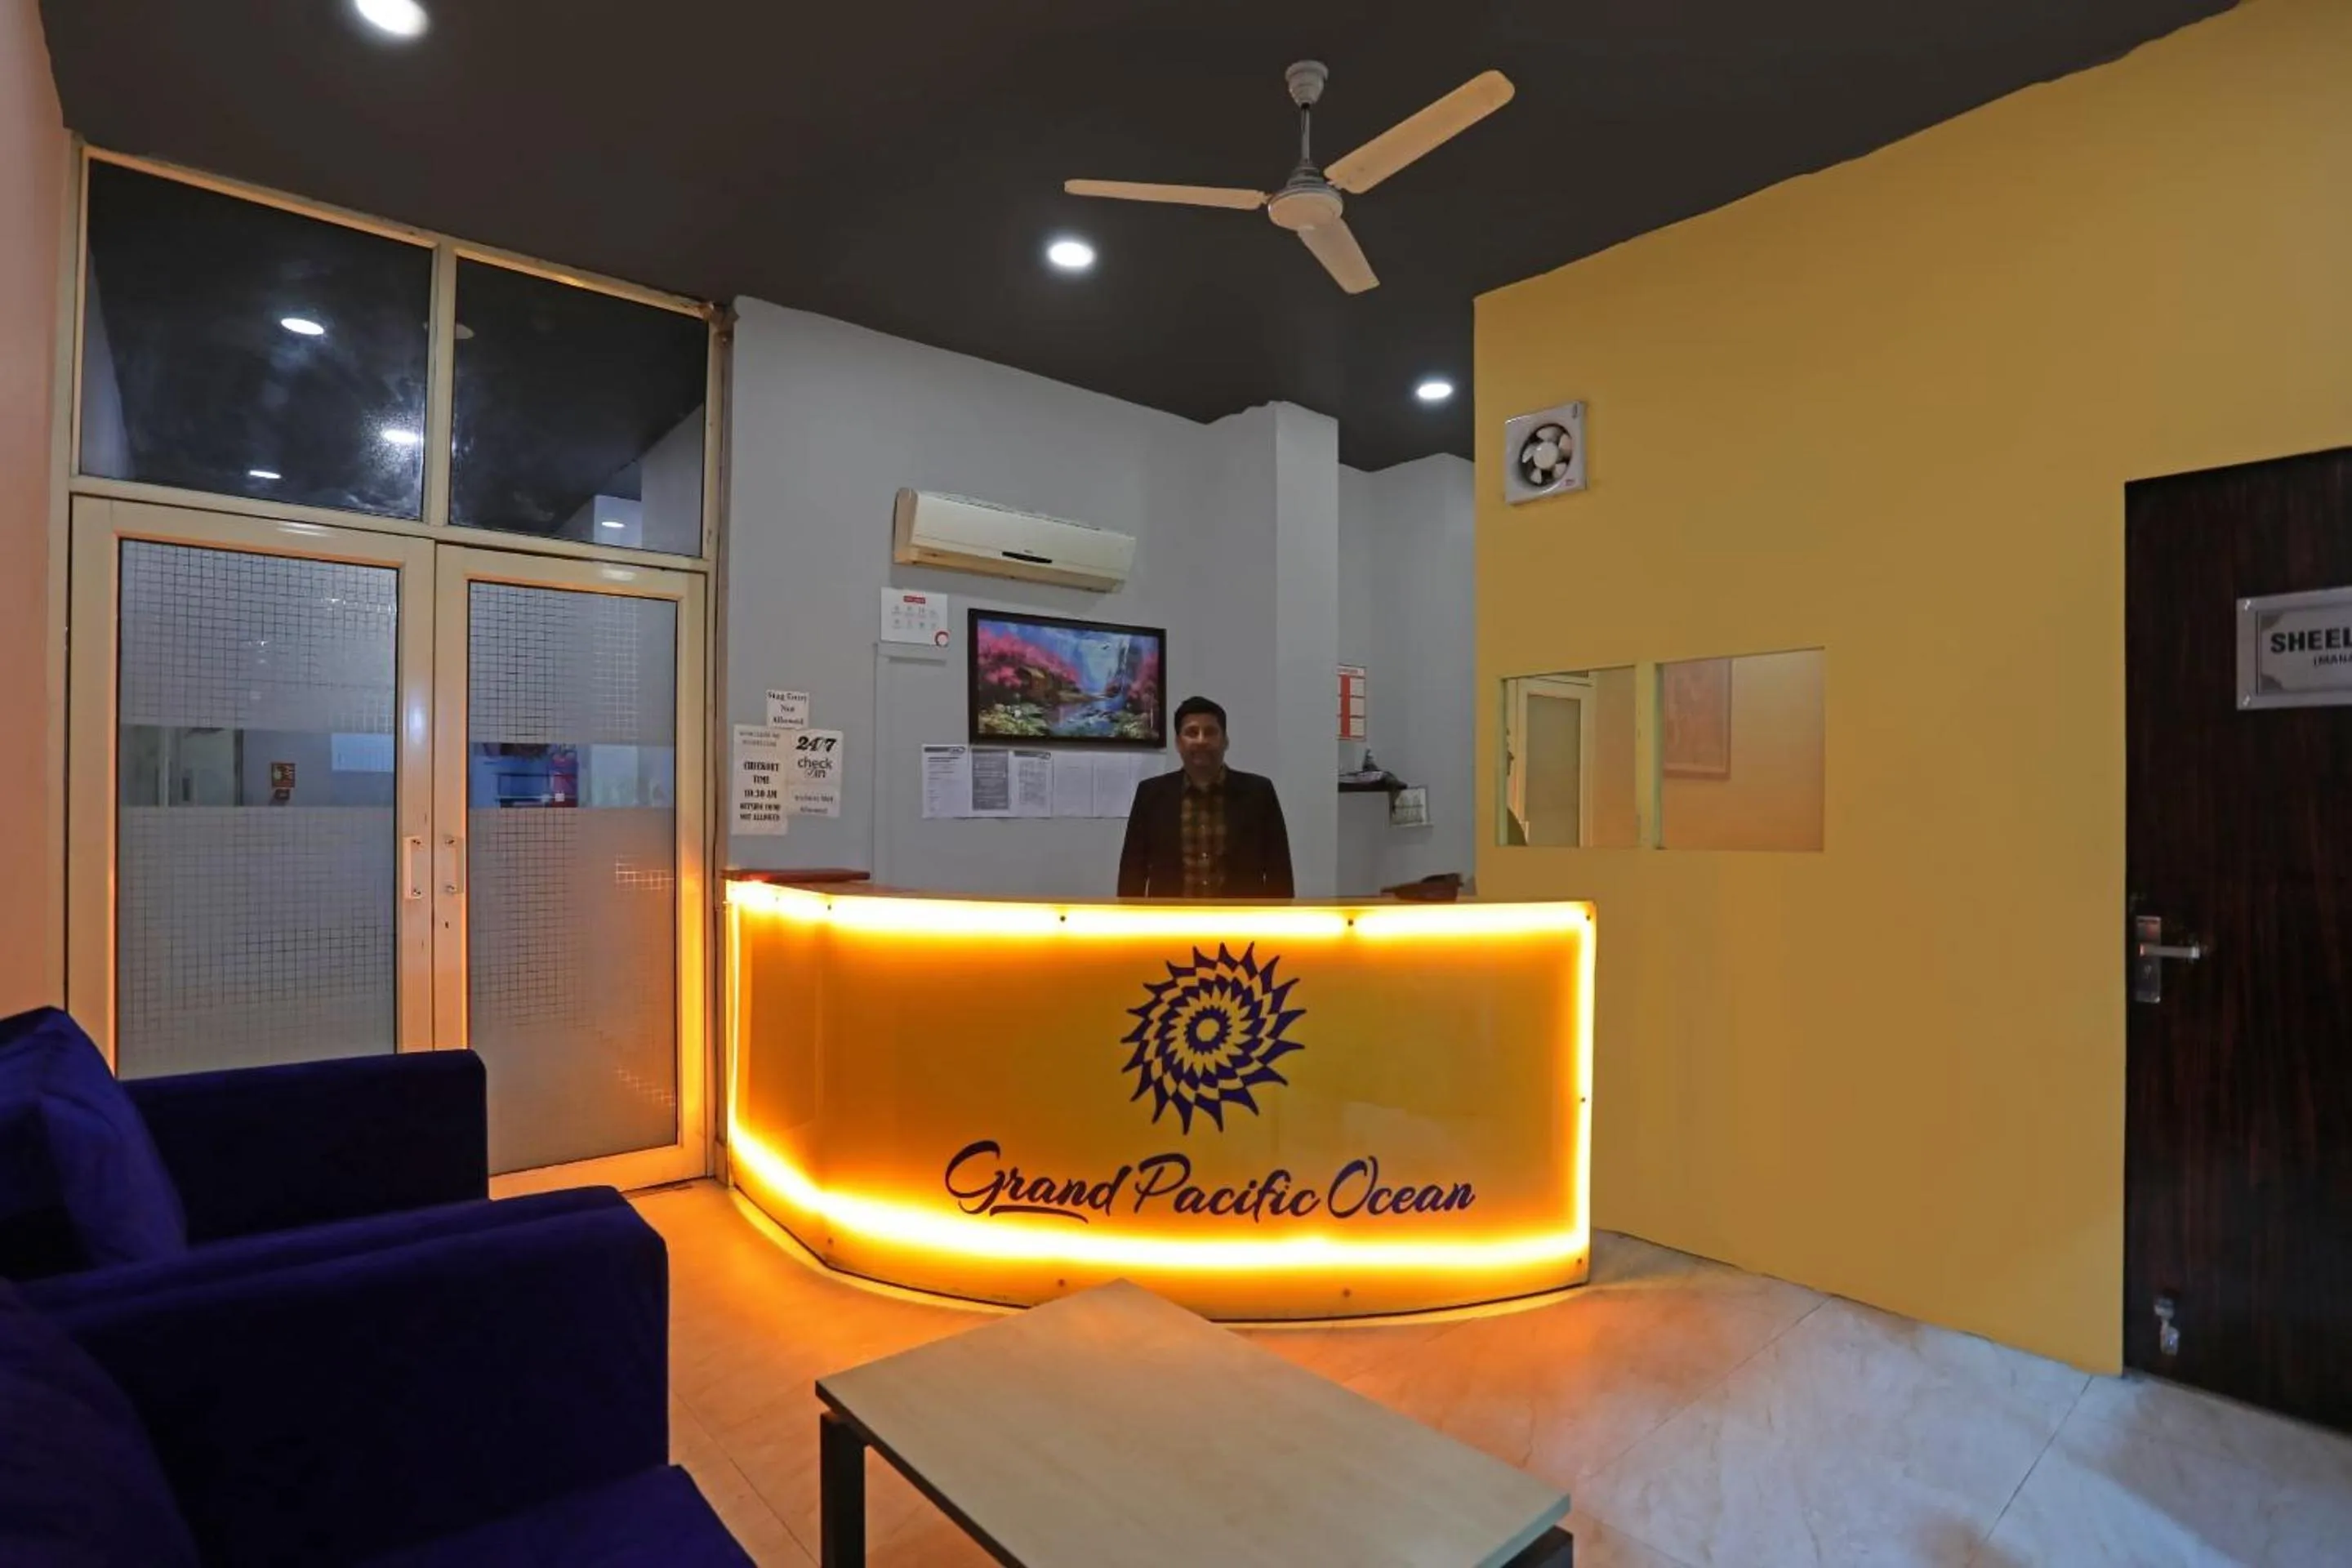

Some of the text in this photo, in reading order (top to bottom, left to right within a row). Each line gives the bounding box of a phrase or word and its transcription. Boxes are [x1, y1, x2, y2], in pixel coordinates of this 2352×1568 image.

[2270, 627, 2352, 654] SHEEL
[795, 736, 837, 752] 24/7
[797, 756, 833, 769] check
[753, 775, 769, 785] TIME
[945, 1140, 1476, 1223] Grand Pacific Ocean
